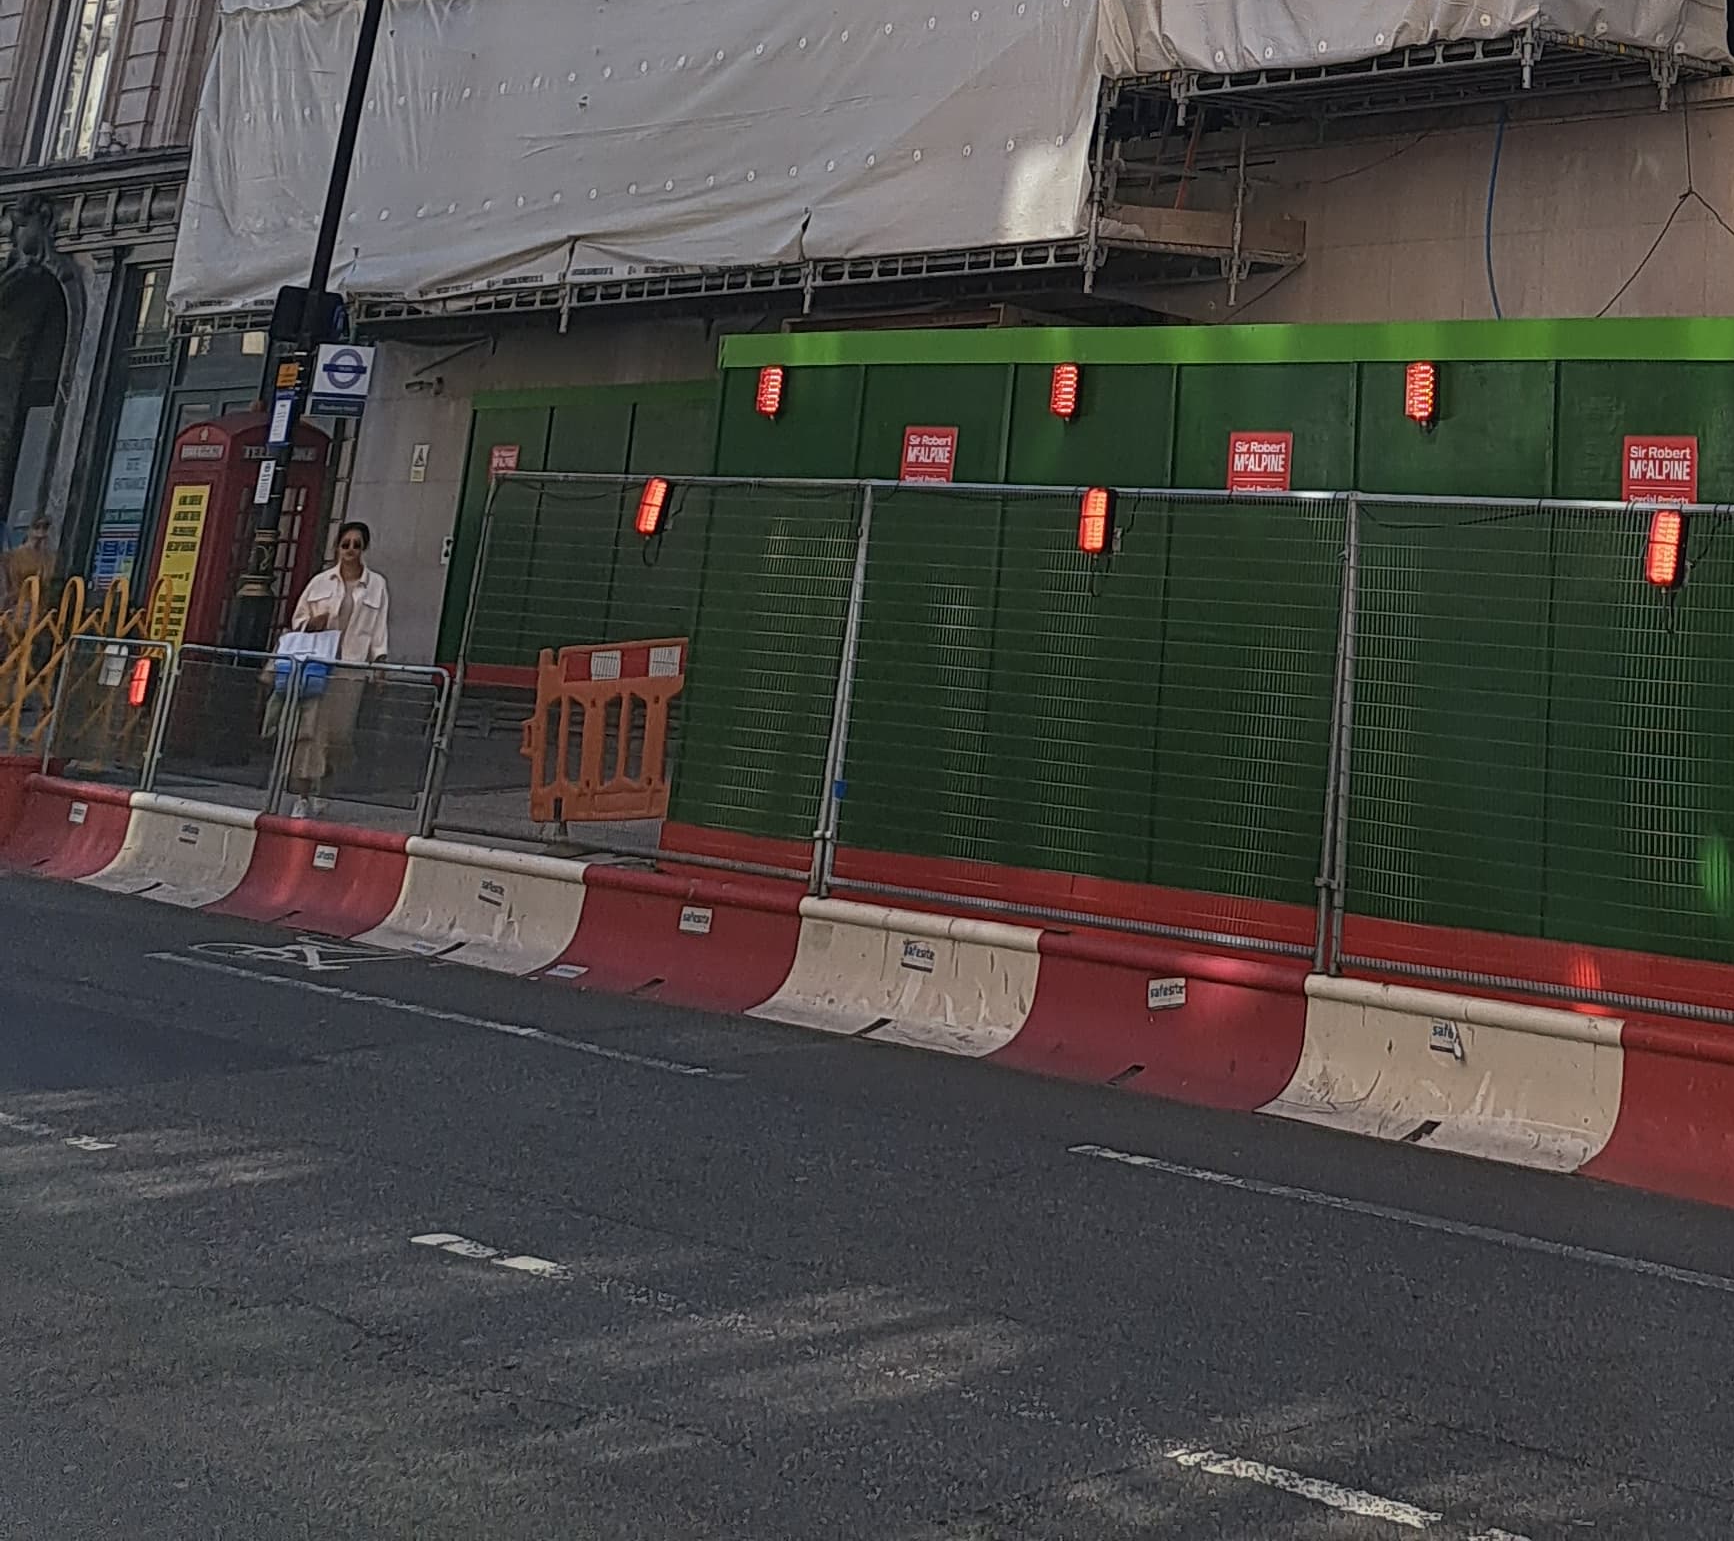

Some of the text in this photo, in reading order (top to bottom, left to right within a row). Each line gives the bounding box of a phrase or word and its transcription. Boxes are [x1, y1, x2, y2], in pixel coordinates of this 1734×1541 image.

[1234, 441, 1286, 453] Sir Robert
[1629, 445, 1691, 459] Sir Robert
[1233, 453, 1286, 473] McALPINE
[1629, 459, 1691, 480] McALPINE
